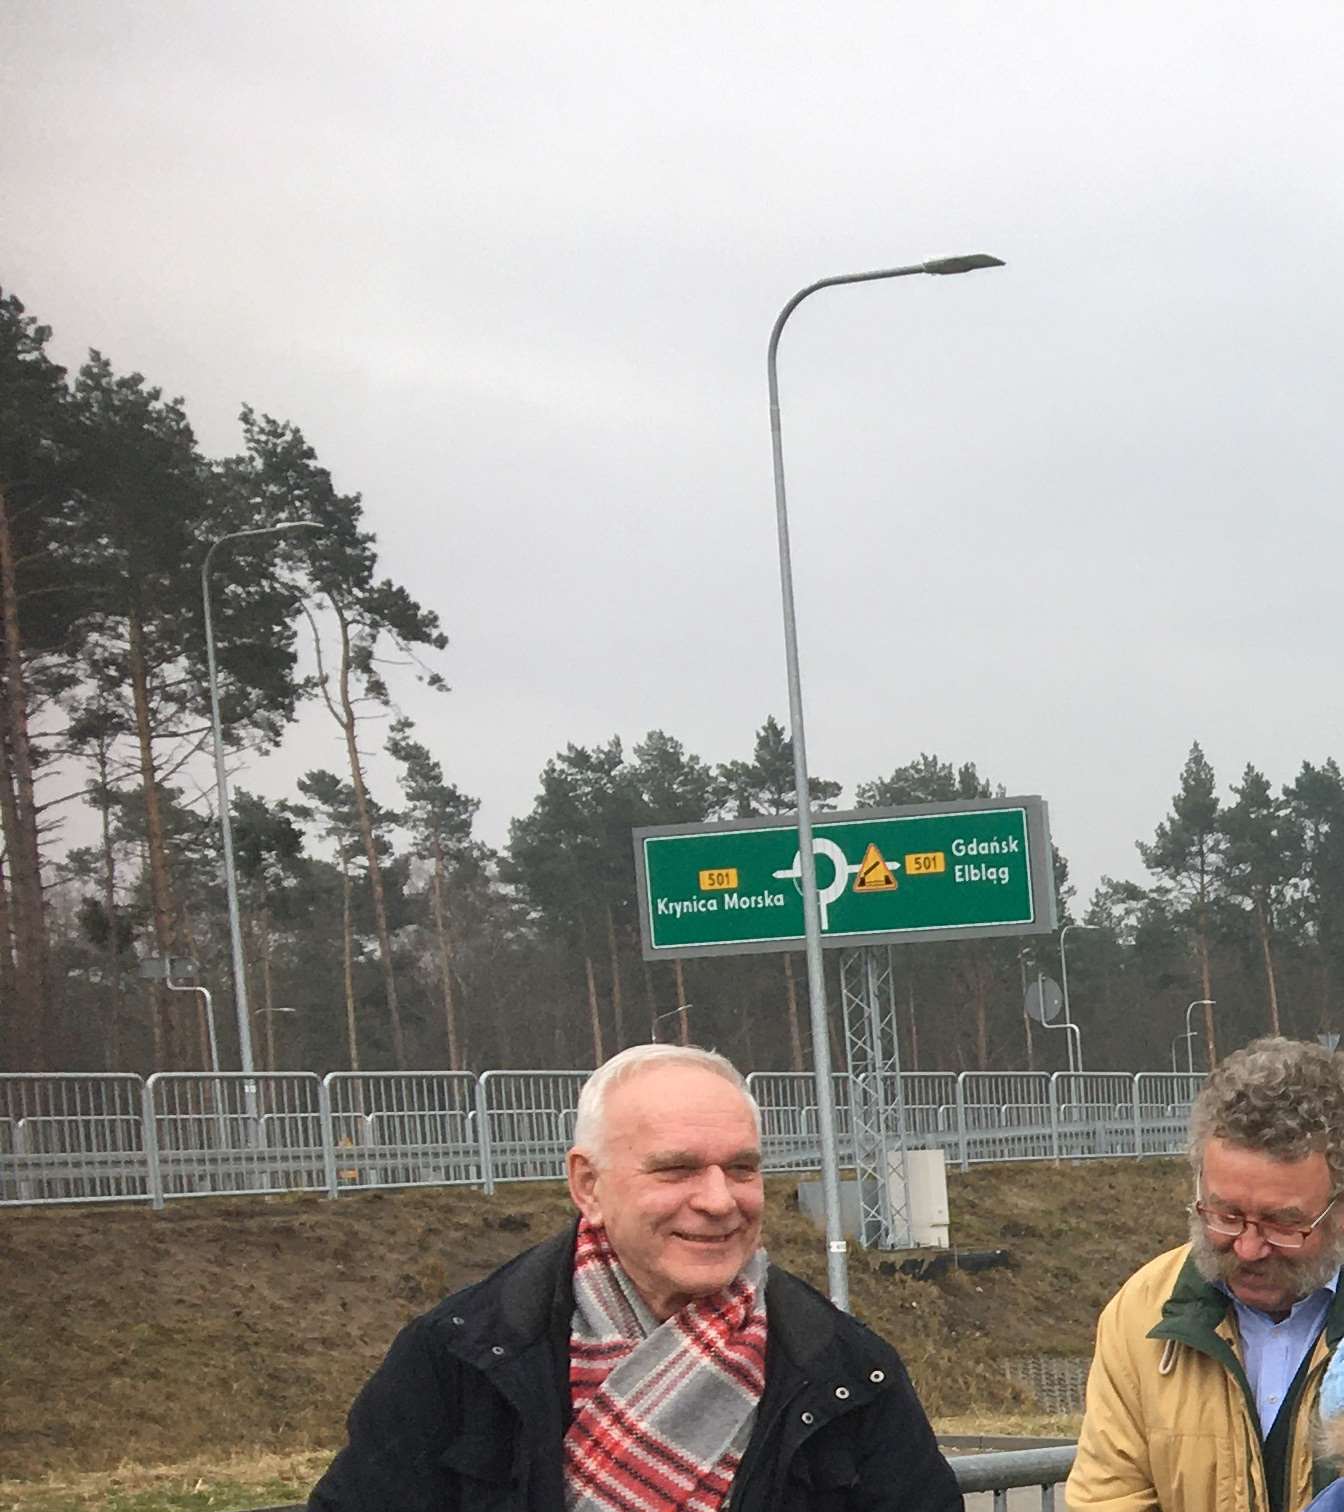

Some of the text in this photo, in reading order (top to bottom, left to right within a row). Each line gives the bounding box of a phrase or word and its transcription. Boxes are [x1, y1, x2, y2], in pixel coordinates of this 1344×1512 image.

[951, 835, 1019, 856] Gdańsk
[914, 855, 937, 871] 501
[954, 863, 1009, 884] Elbląg
[708, 872, 730, 887] 501
[657, 890, 785, 919] Krynica Morska
